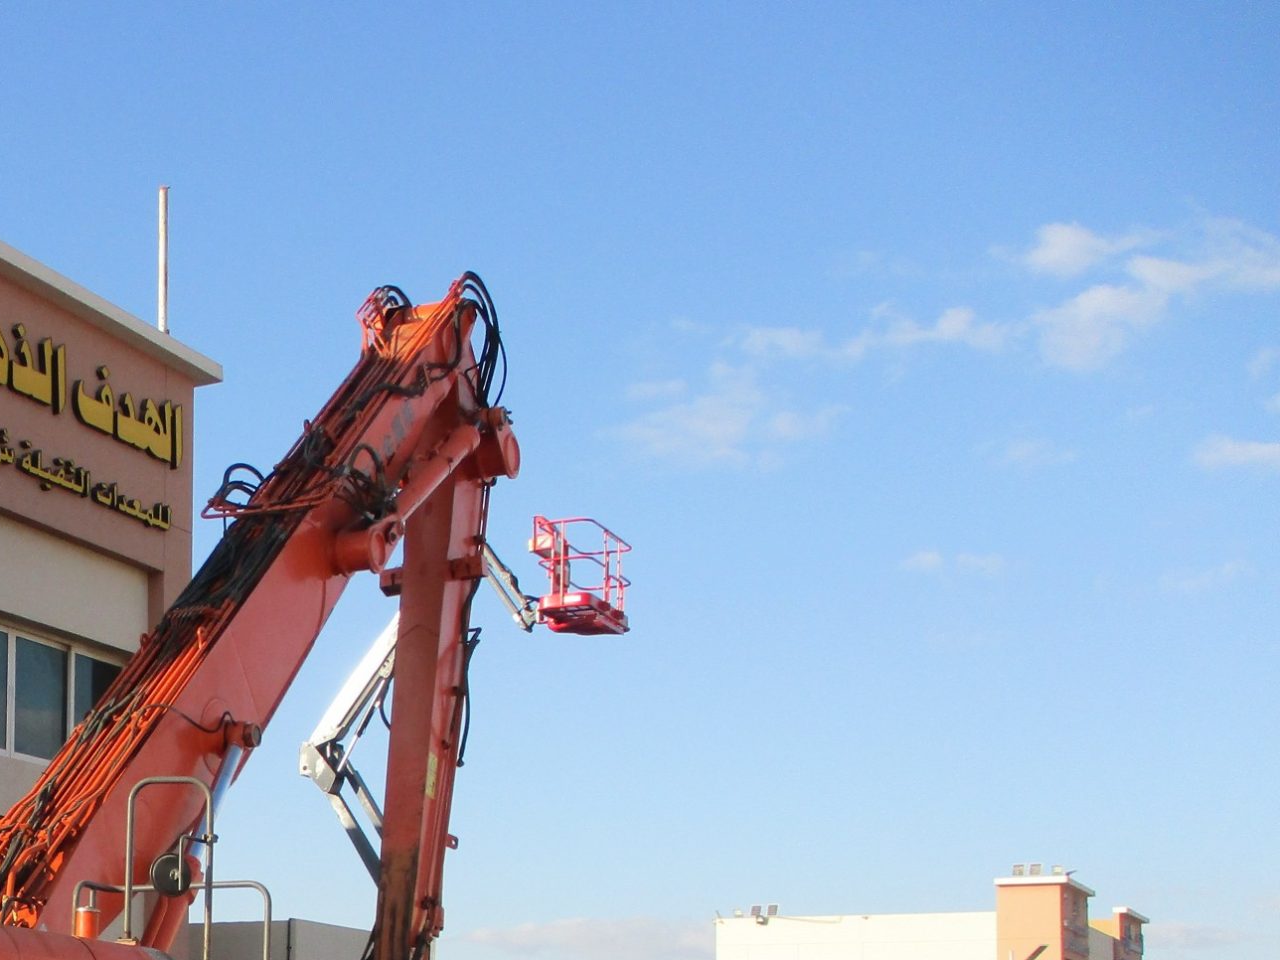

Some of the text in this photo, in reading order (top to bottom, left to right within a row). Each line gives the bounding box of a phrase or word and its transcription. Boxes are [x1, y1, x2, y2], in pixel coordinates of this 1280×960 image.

[73, 365, 183, 469] الهدف
[17, 440, 90, 497] الثقيلة
[91, 482, 171, 531] للمعدات
